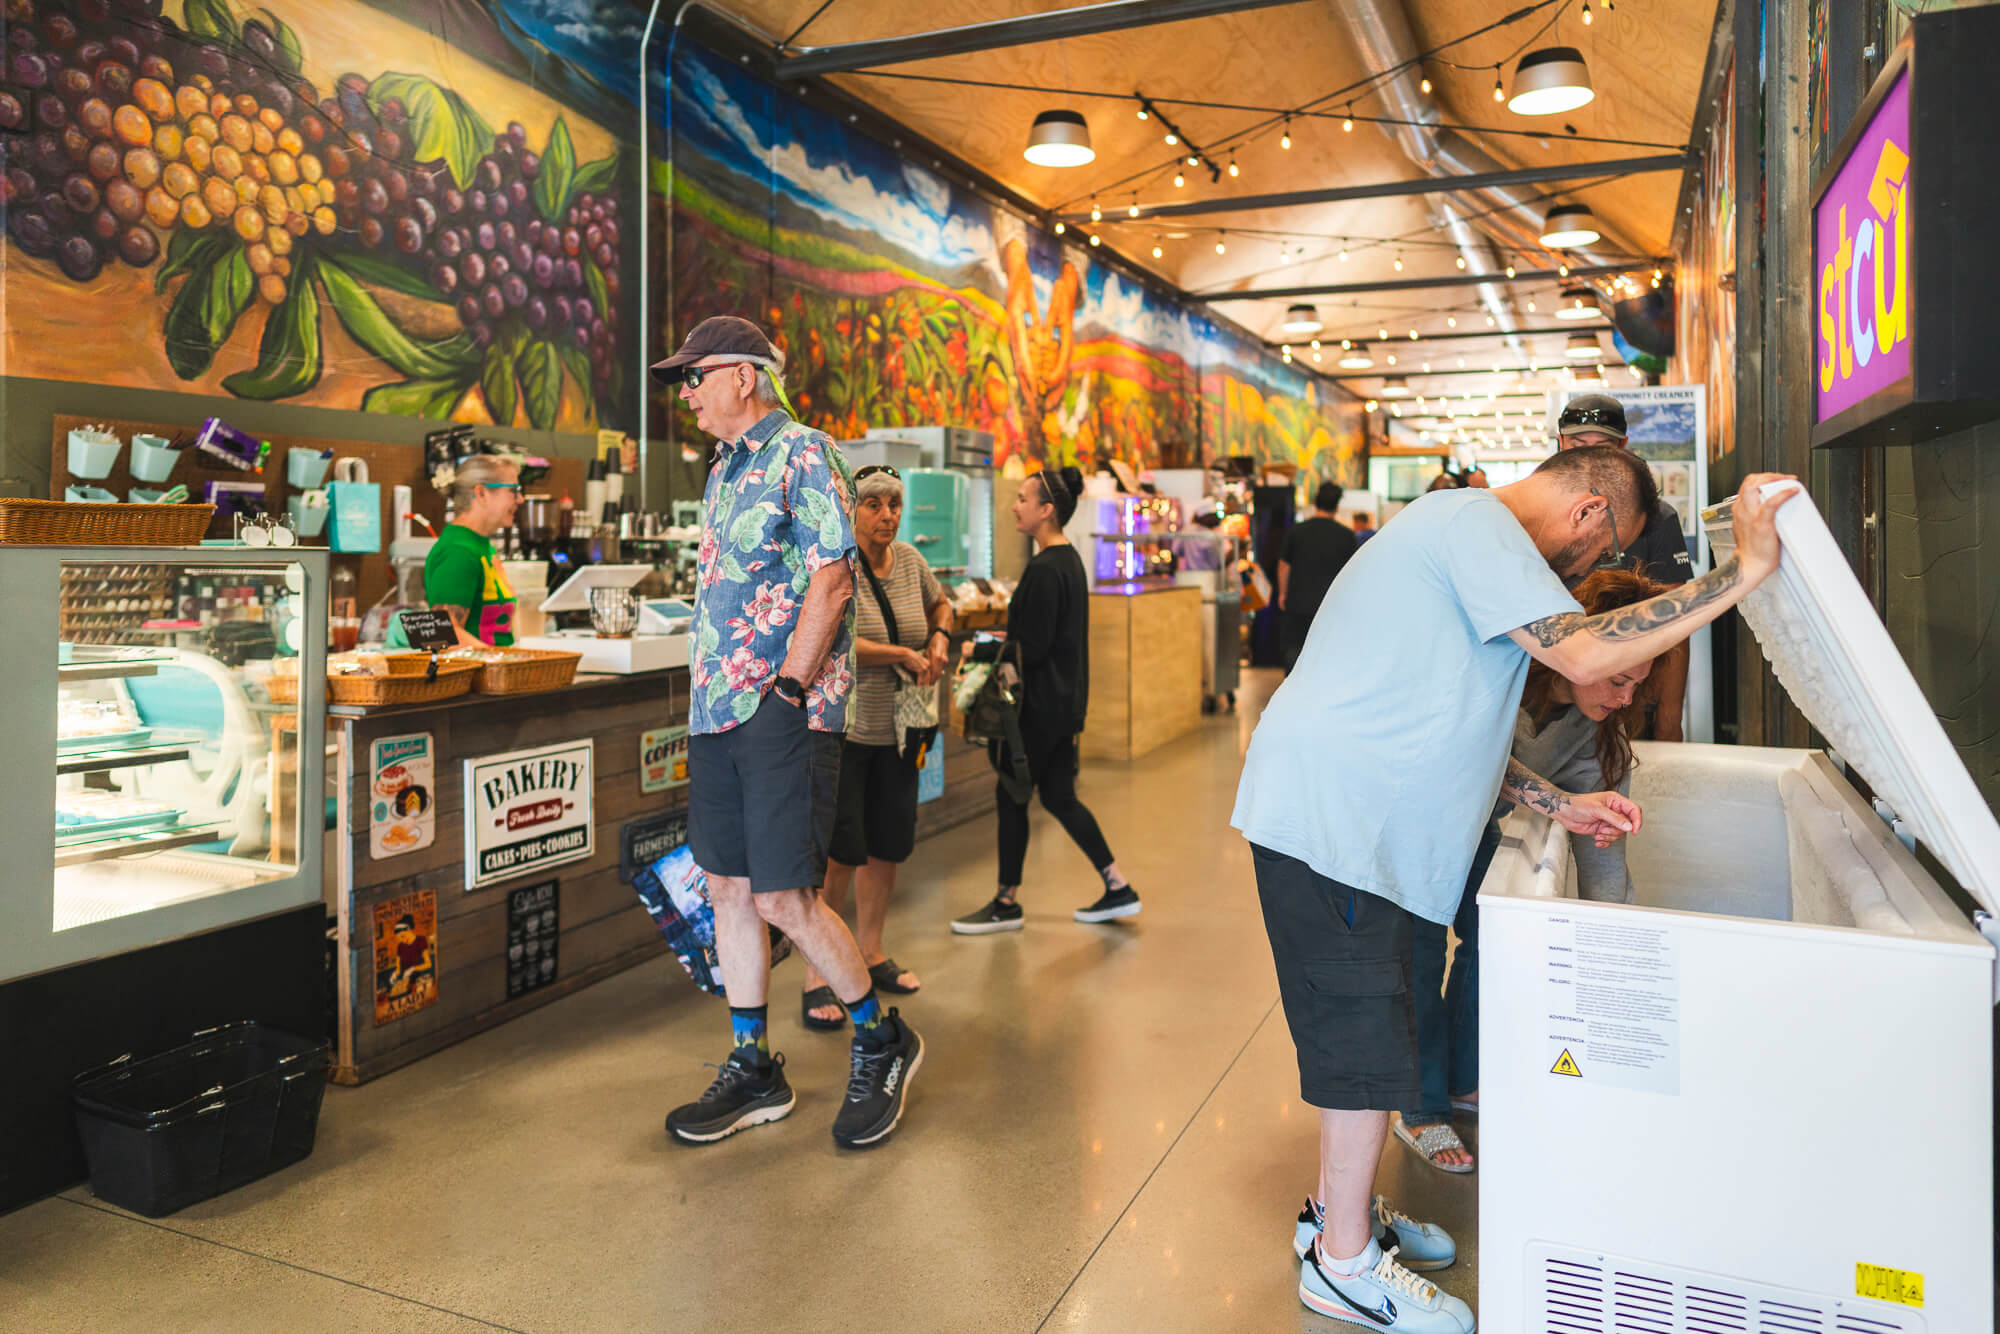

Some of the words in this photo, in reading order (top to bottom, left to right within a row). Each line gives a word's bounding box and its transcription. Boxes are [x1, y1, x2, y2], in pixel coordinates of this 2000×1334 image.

[1820, 181, 1907, 393] stcu
[645, 735, 688, 766] COFFE
[483, 759, 584, 810] BAKERY
[485, 848, 515, 870] CAKES
[520, 841, 541, 861] PIES
[546, 831, 584, 854] COOKIES
